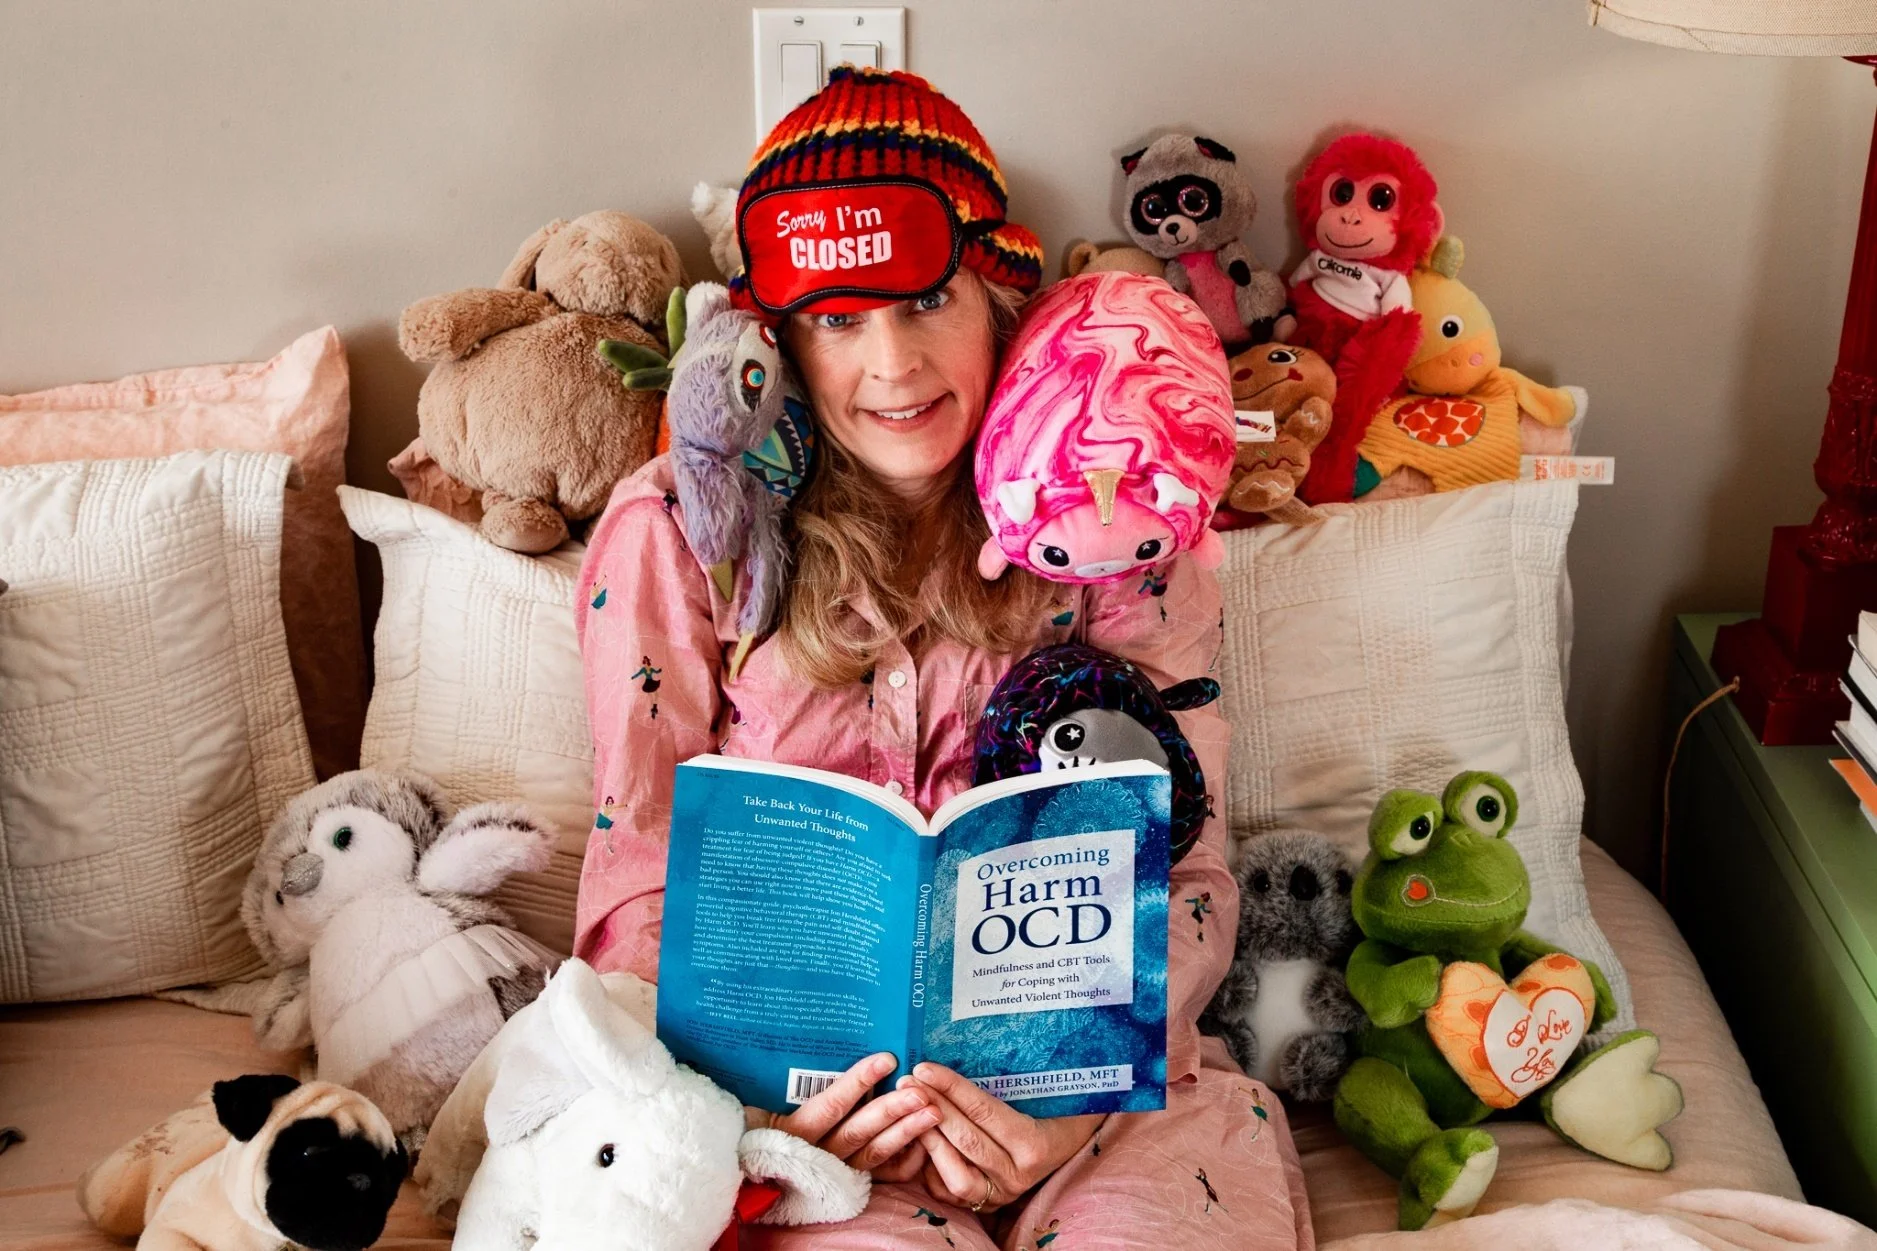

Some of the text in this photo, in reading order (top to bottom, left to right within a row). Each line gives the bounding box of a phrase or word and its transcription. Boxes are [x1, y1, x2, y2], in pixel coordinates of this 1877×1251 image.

[776, 206, 882, 238] Sorry I'm
[790, 231, 892, 271] CLOSED
[743, 796, 868, 831] Take Back Your Life from
[755, 814, 856, 842] Unwanted Thoughts
[978, 846, 1110, 881] Overcoming
[982, 875, 1102, 912] Harm
[972, 903, 1112, 955] OCD
[912, 884, 932, 1008] Overcoming Harm OCD
[973, 954, 1110, 977] Mindfulness and CBT Tools
[1001, 973, 1080, 991] for Coping with
[972, 987, 1111, 1008] Unwanted Violent Thoughts
[1507, 1010, 1573, 1047] I Love
[995, 1072, 1085, 1089] HERSHFIELD,
[1090, 1068, 1119, 1080] MFT
[1010, 1086, 1055, 1096] JONATHAN
[1058, 1082, 1100, 1091] GRAYSON,
